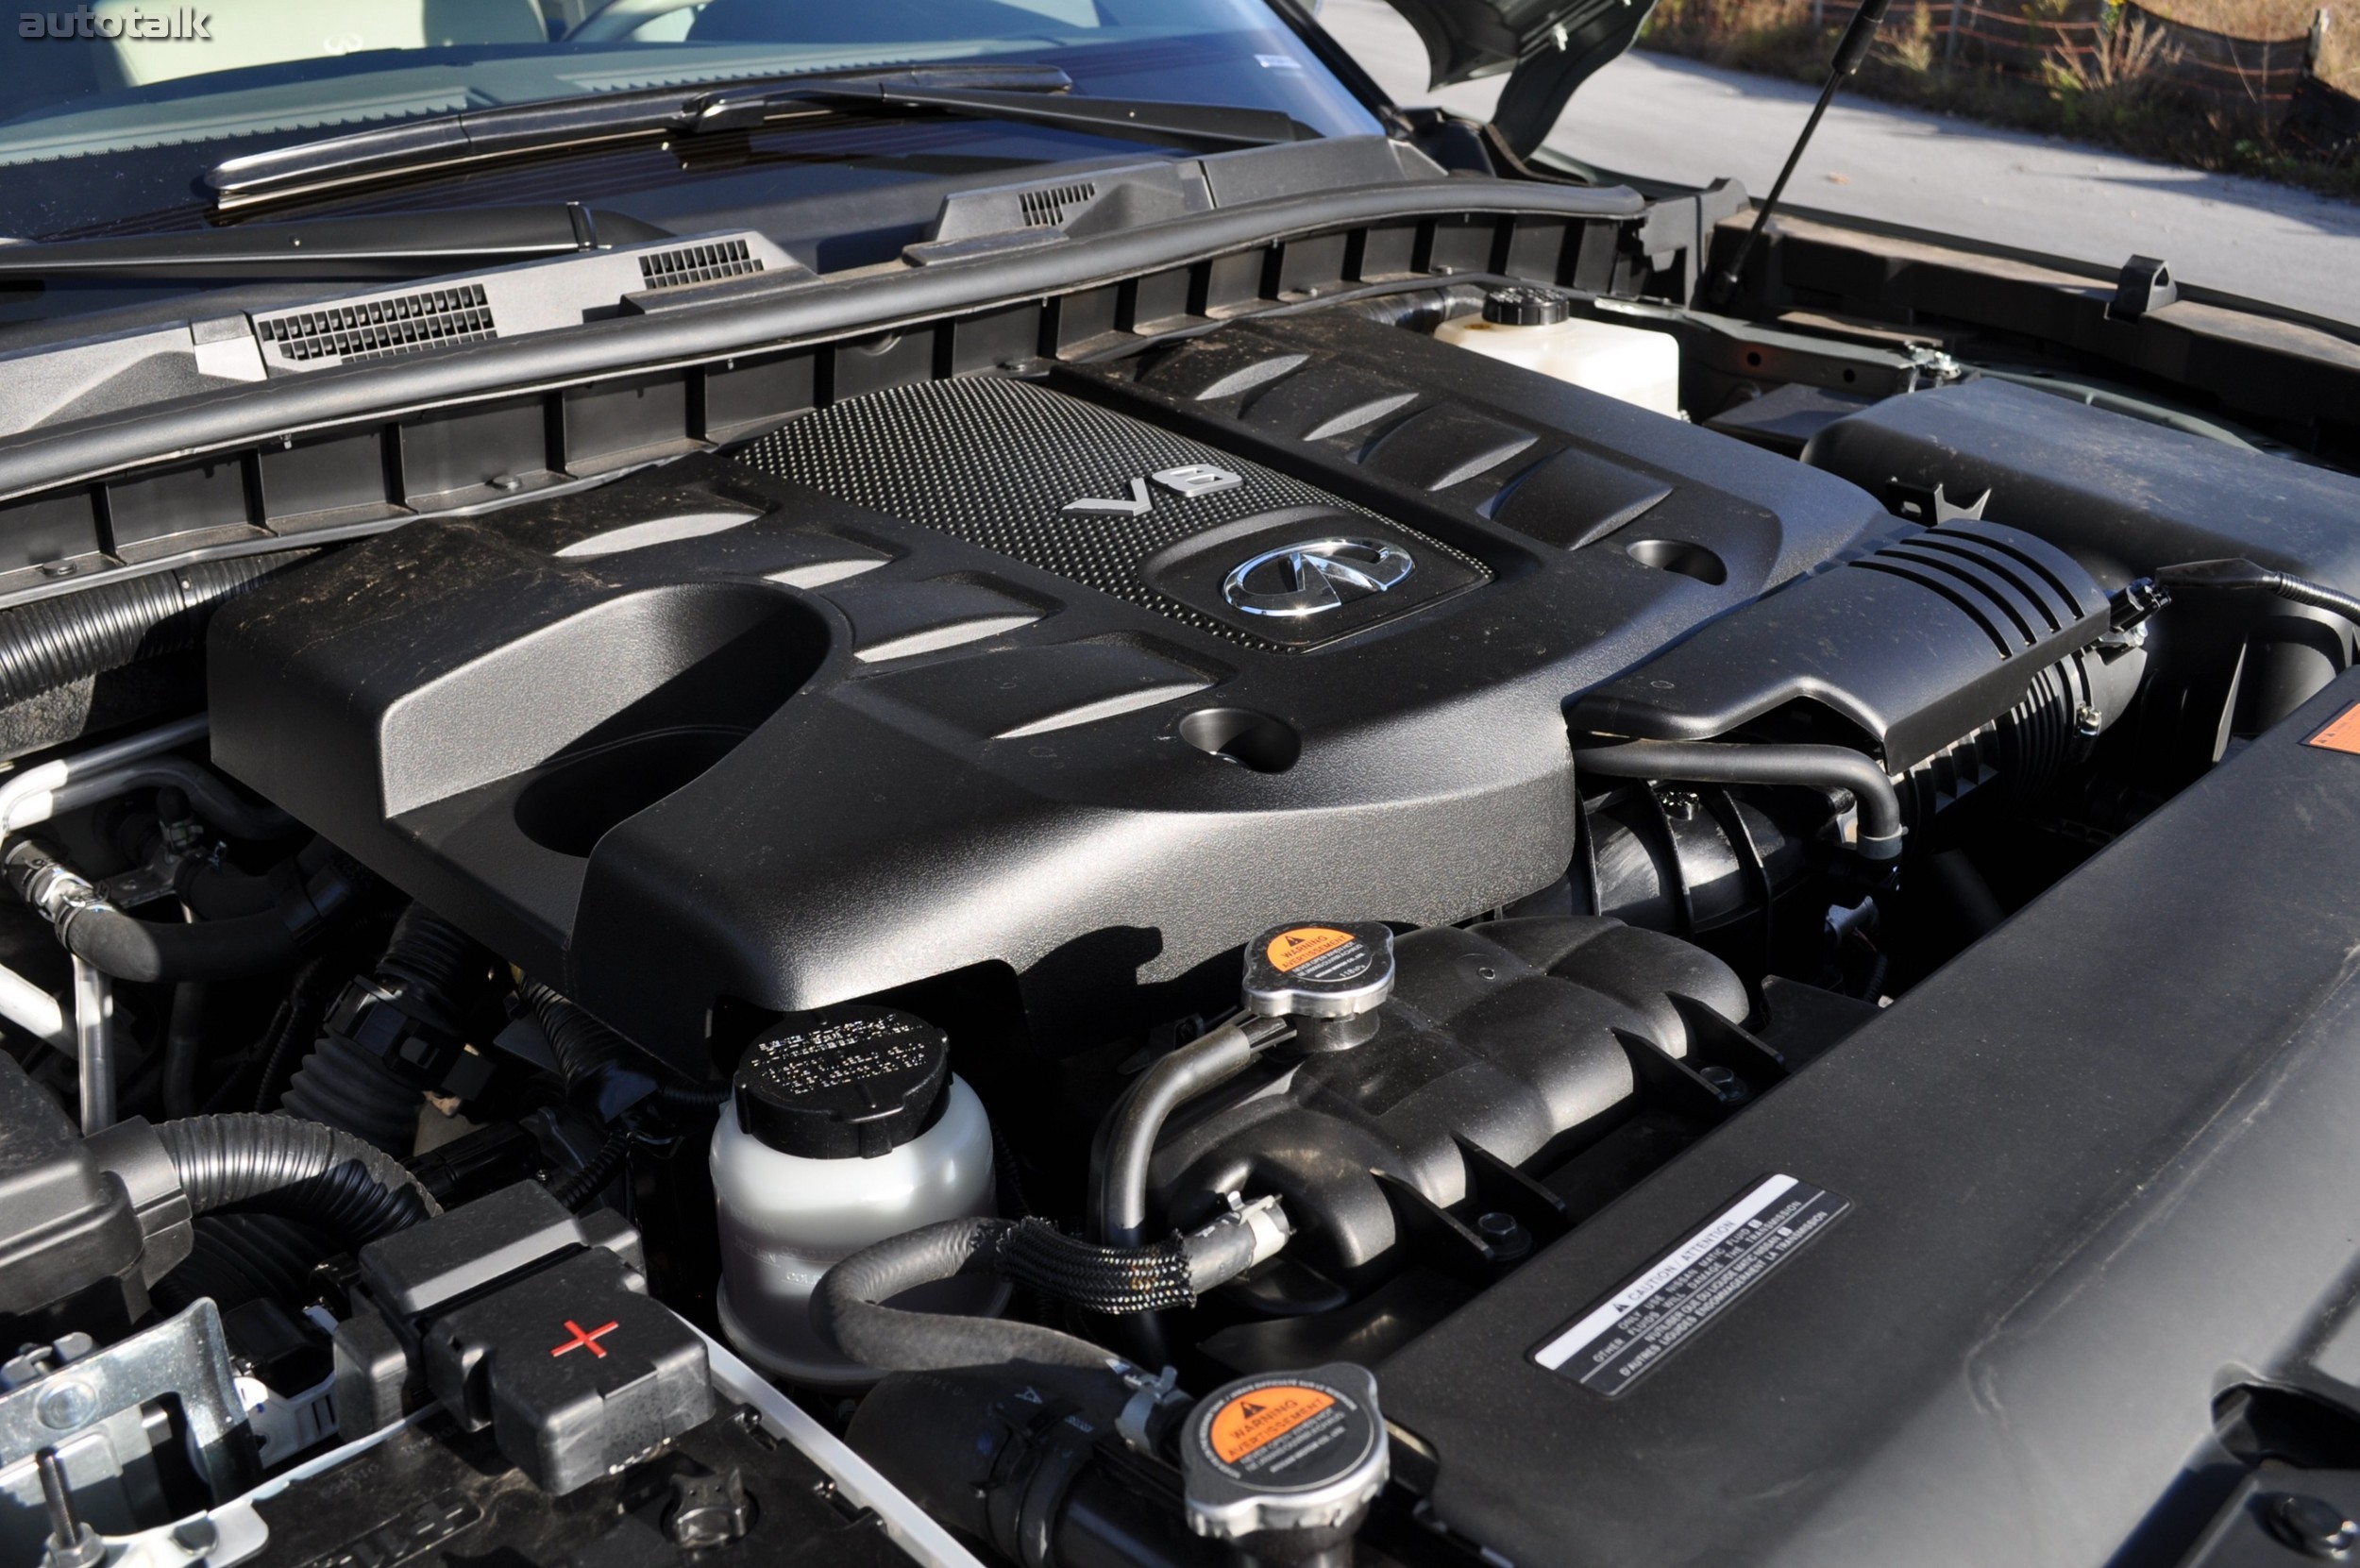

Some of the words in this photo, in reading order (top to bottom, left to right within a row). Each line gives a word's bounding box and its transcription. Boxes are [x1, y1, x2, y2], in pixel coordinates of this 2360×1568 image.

[1281, 936, 1328, 958] WARNING
[1282, 936, 1346, 968] AVERTISSEMENT
[1627, 1264, 1676, 1301] CAUTION
[1681, 1220, 1734, 1260] ATTENTION
[1763, 1249, 1778, 1261] LA
[1775, 1209, 1828, 1252] TRANSMISSION
[1593, 1337, 1625, 1363] OTHER
[1627, 1309, 1660, 1336] FLUIDS
[1661, 1290, 1684, 1309] WILL
[1687, 1260, 1723, 1290] DAMAGE
[1725, 1245, 1743, 1259] THE
[1745, 1199, 1801, 1243] TRANSMISSION
[1617, 1309, 1643, 1330] ONLY
[1644, 1293, 1663, 1310] USE
[1665, 1268, 1697, 1293] NISSAN
[1698, 1246, 1725, 1268] MATIC
[1726, 1226, 1750, 1246] FLUID
[1228, 1398, 1323, 1457] AVERTISSEMENT
[1230, 1400, 1298, 1439] WARNING
